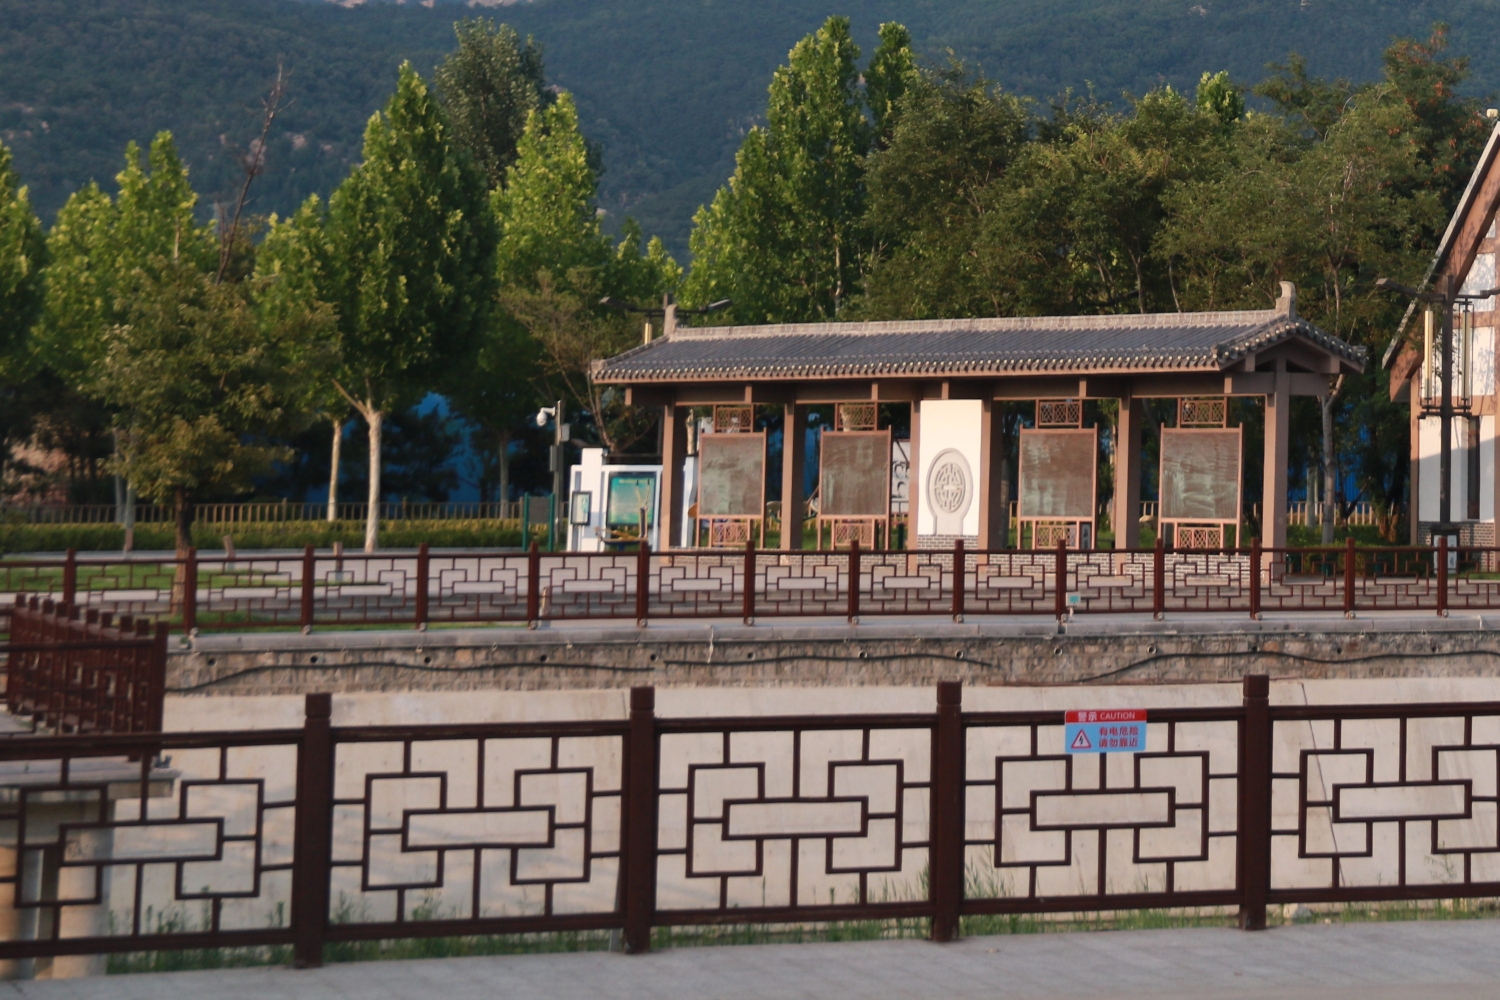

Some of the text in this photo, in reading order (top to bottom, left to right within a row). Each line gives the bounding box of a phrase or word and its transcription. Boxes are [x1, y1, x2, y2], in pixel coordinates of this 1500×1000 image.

[1078, 711, 1135, 721] 警示 CAUTION
[1099, 726, 1138, 736] 有电危险
[1099, 737, 1138, 748] 请勿靠近
